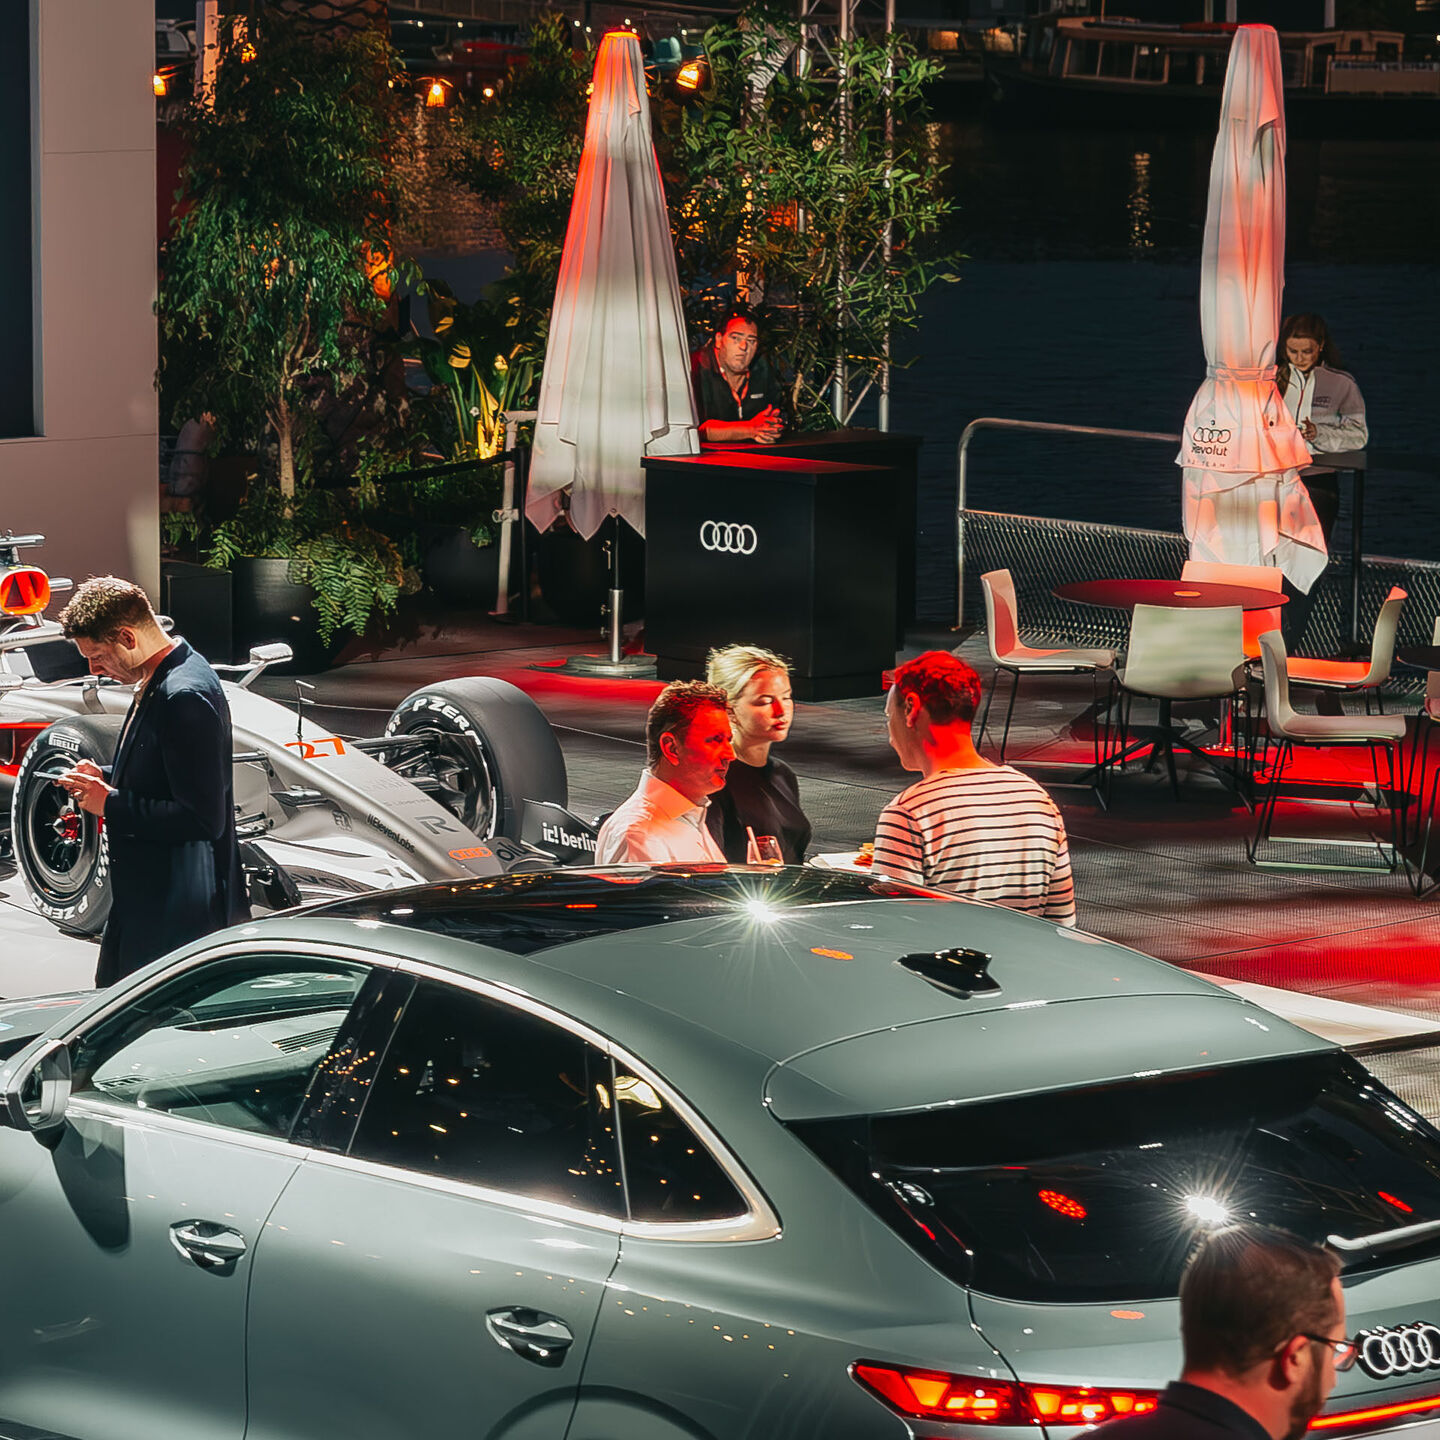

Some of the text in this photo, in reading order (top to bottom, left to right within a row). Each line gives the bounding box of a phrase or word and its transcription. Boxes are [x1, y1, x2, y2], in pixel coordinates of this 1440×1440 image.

[48, 732, 81, 752] PIRELLI
[284, 737, 346, 761] 27
[560, 827, 597, 853] berlin
